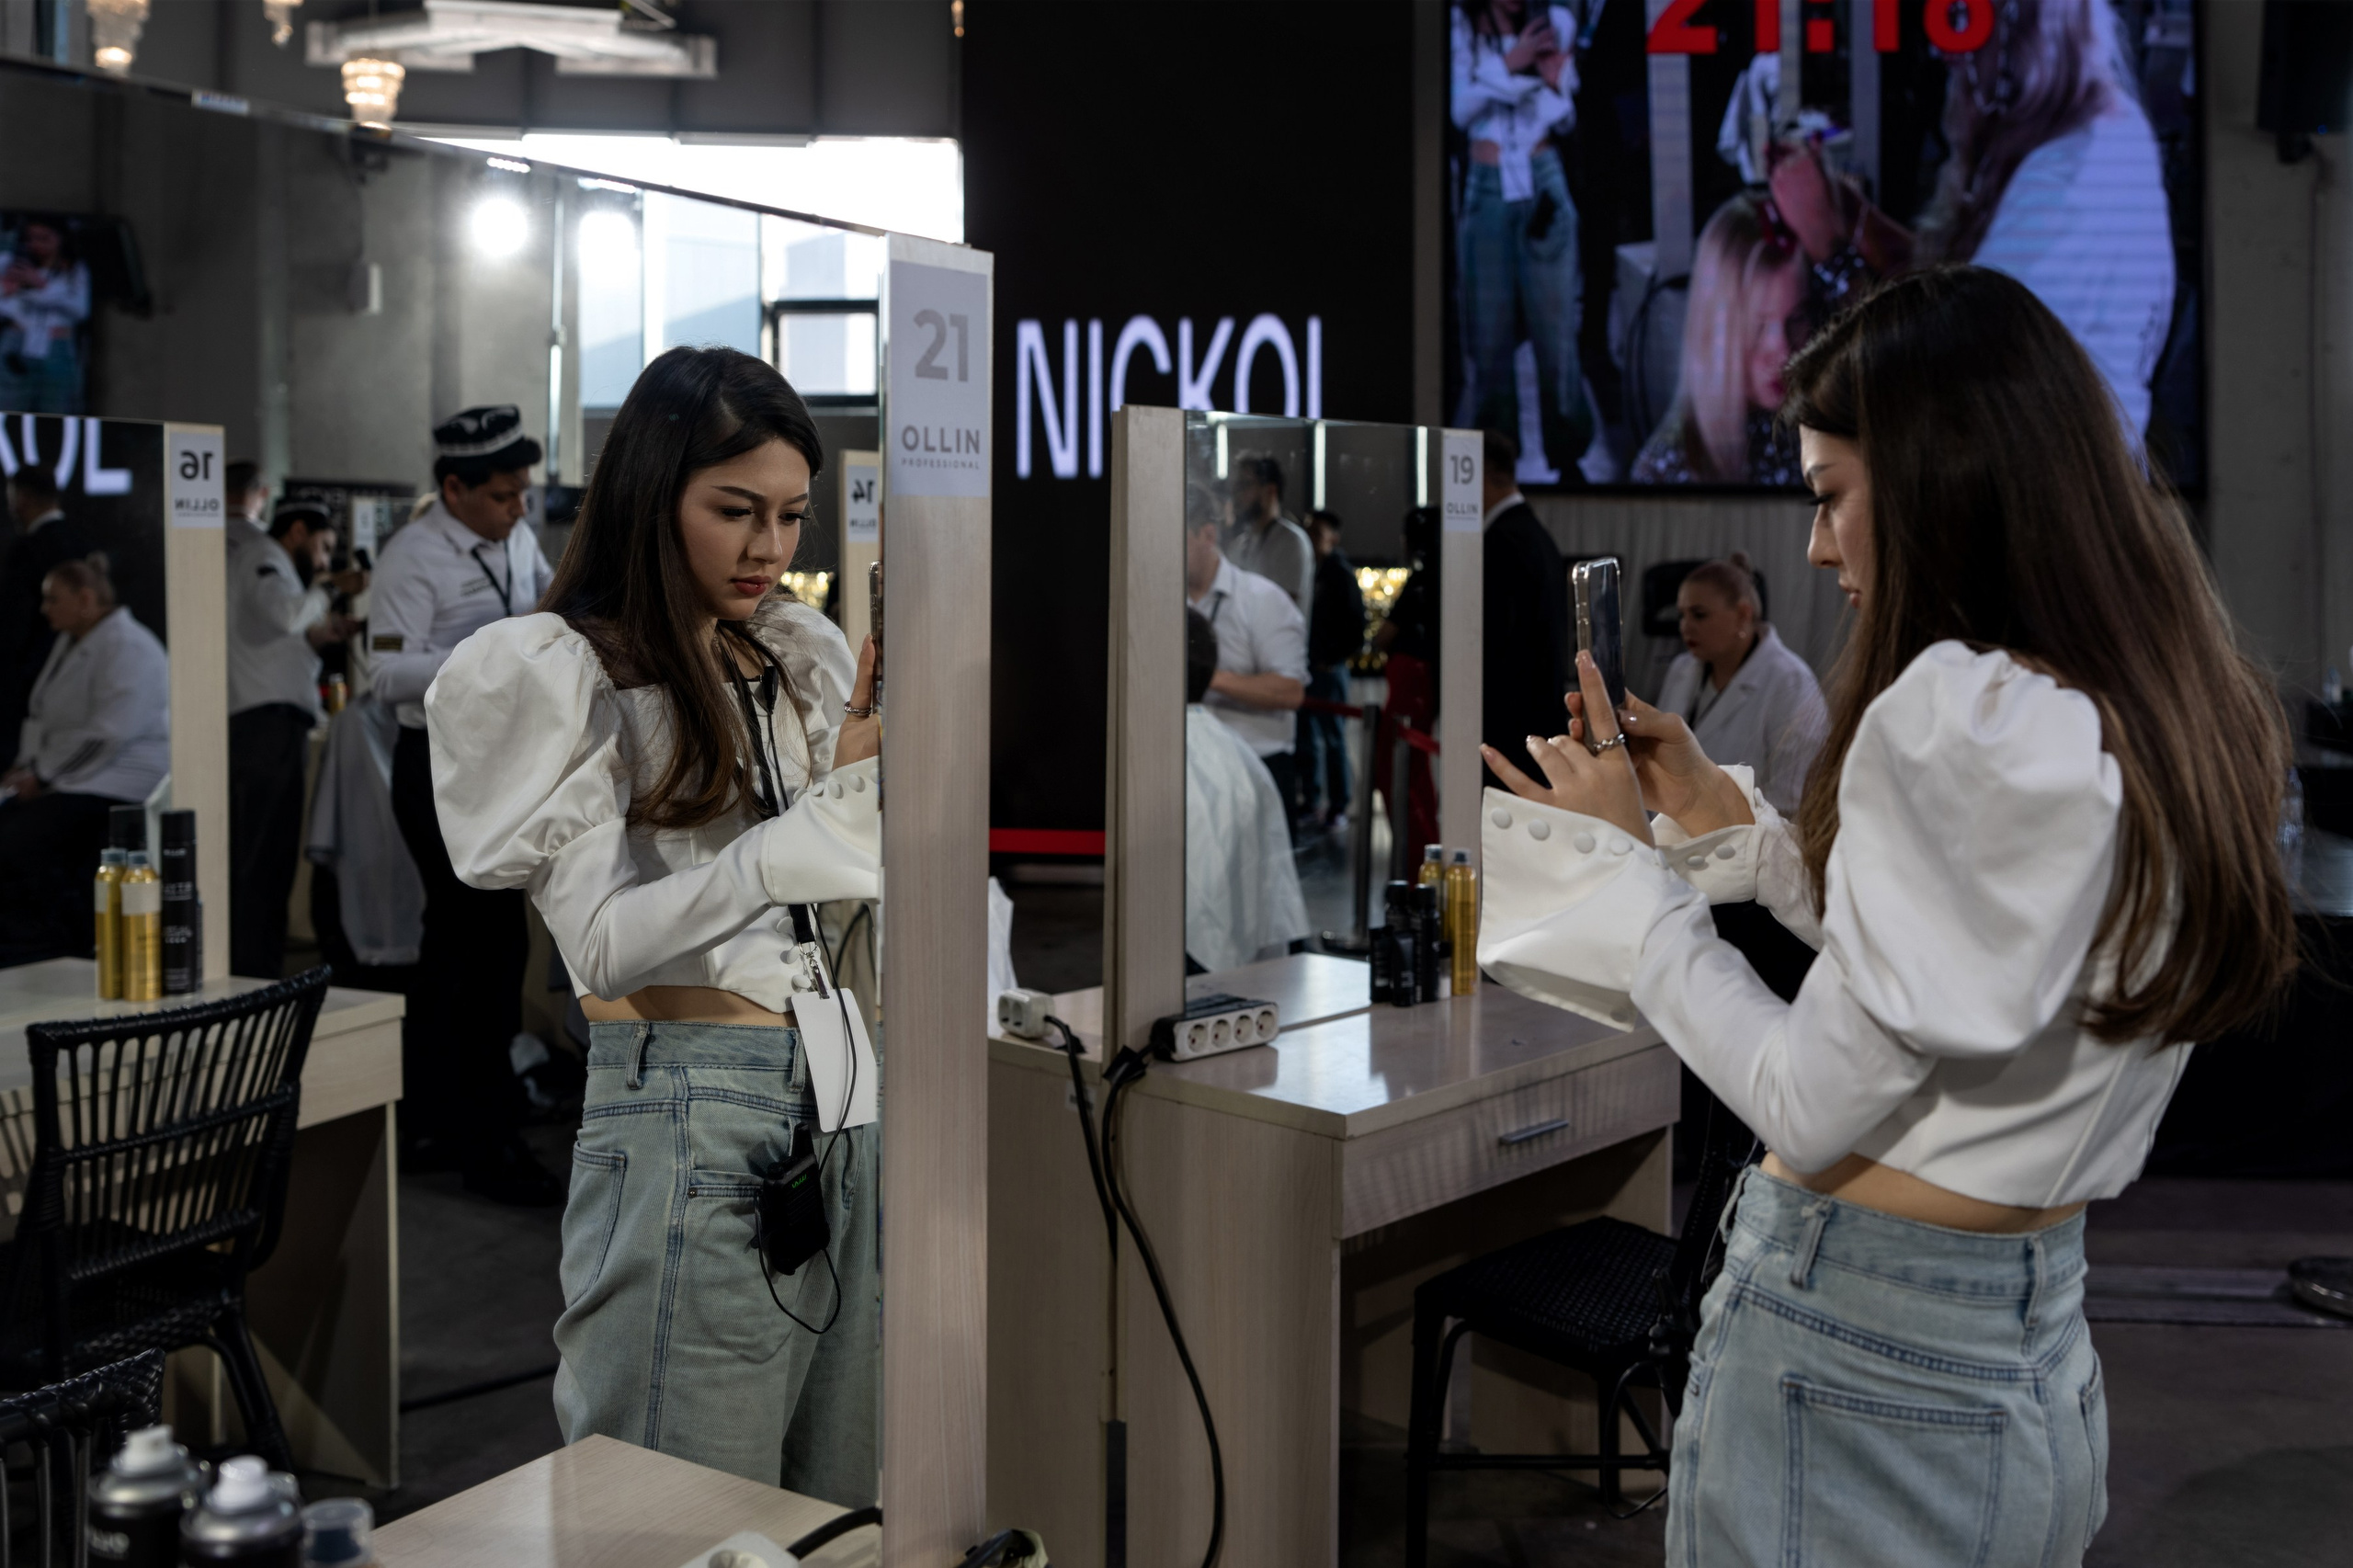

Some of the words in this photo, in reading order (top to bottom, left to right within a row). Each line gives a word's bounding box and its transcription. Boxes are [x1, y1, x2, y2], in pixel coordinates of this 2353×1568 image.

[913, 308, 969, 382] 21
[901, 424, 981, 455] OLLIN
[1449, 454, 1475, 485] 19
[1446, 502, 1479, 515] OLLIN
